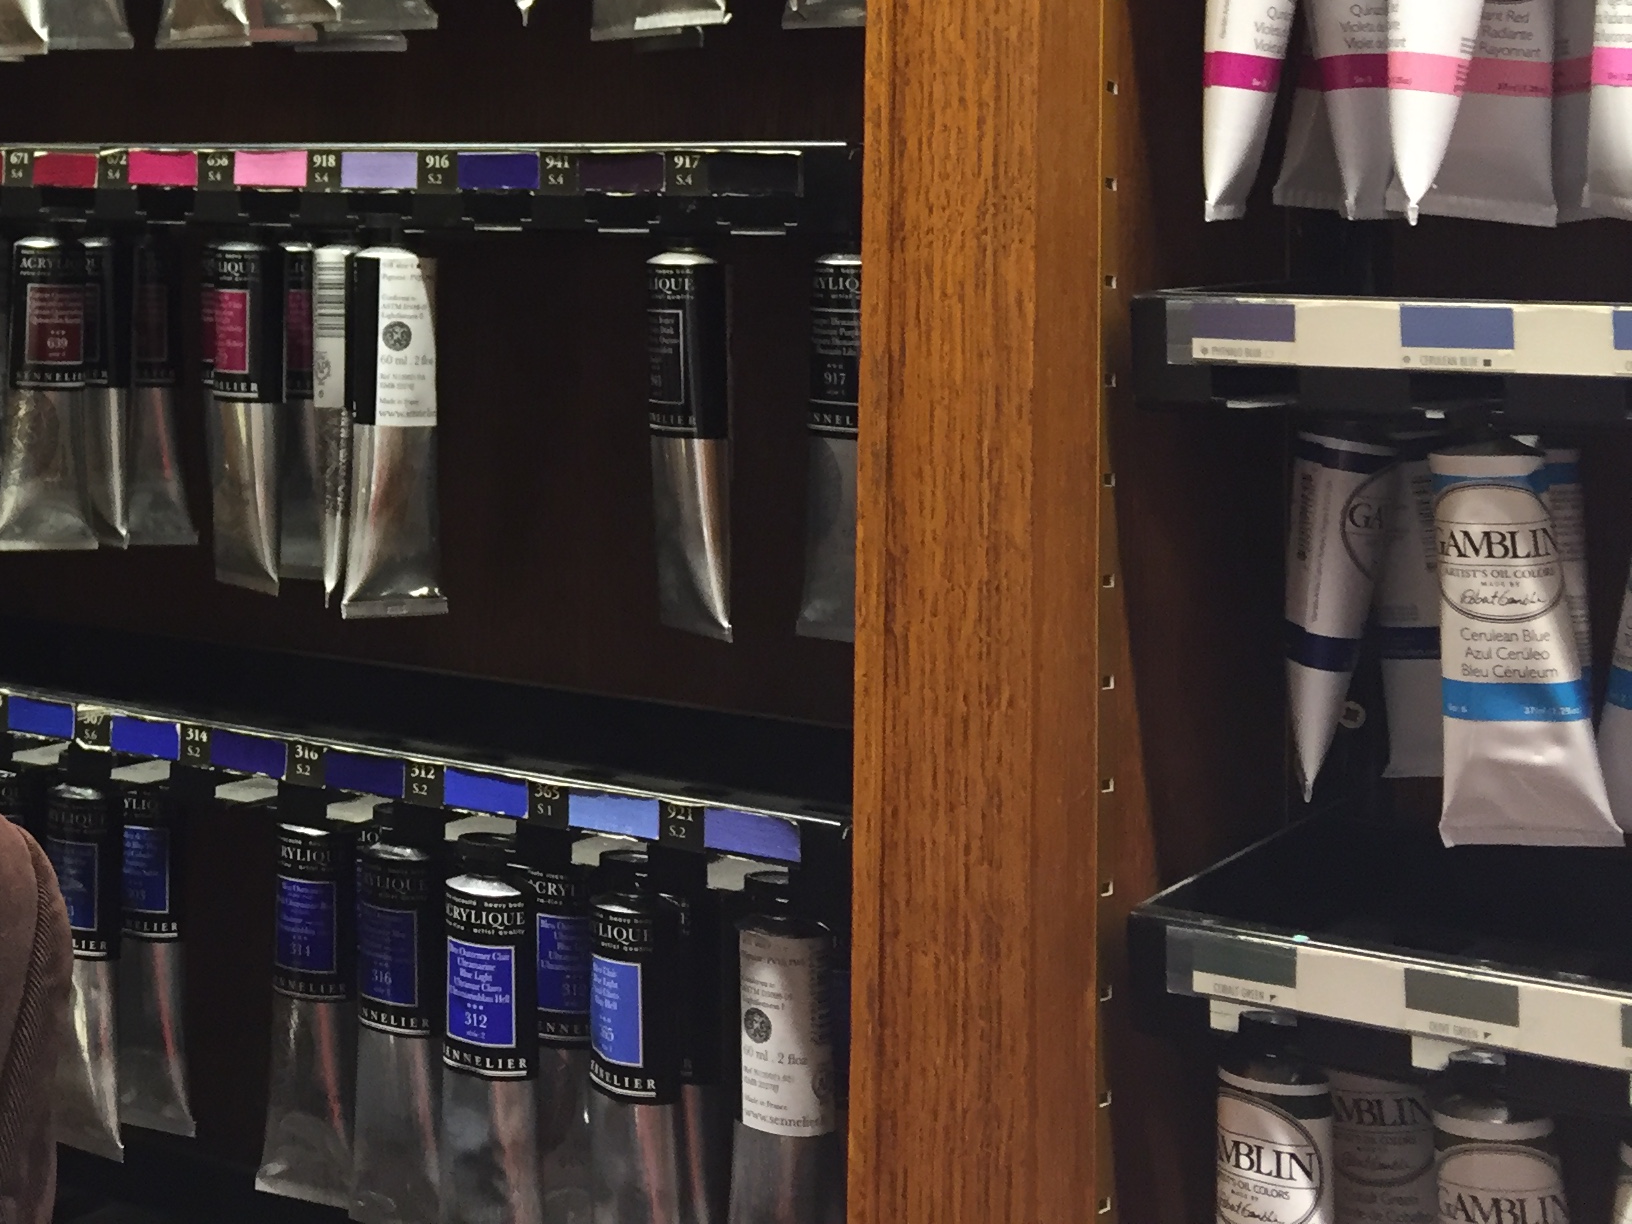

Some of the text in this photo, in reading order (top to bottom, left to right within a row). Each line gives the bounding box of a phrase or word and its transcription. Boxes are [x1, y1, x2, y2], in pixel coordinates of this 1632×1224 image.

[1459, 626, 1552, 643] Cerulean Blue
[1464, 645, 1494, 661] Azul
[1460, 662, 1490, 679] Bleu
[371, 969, 393, 985] 316
[464, 1011, 488, 1028] 312
